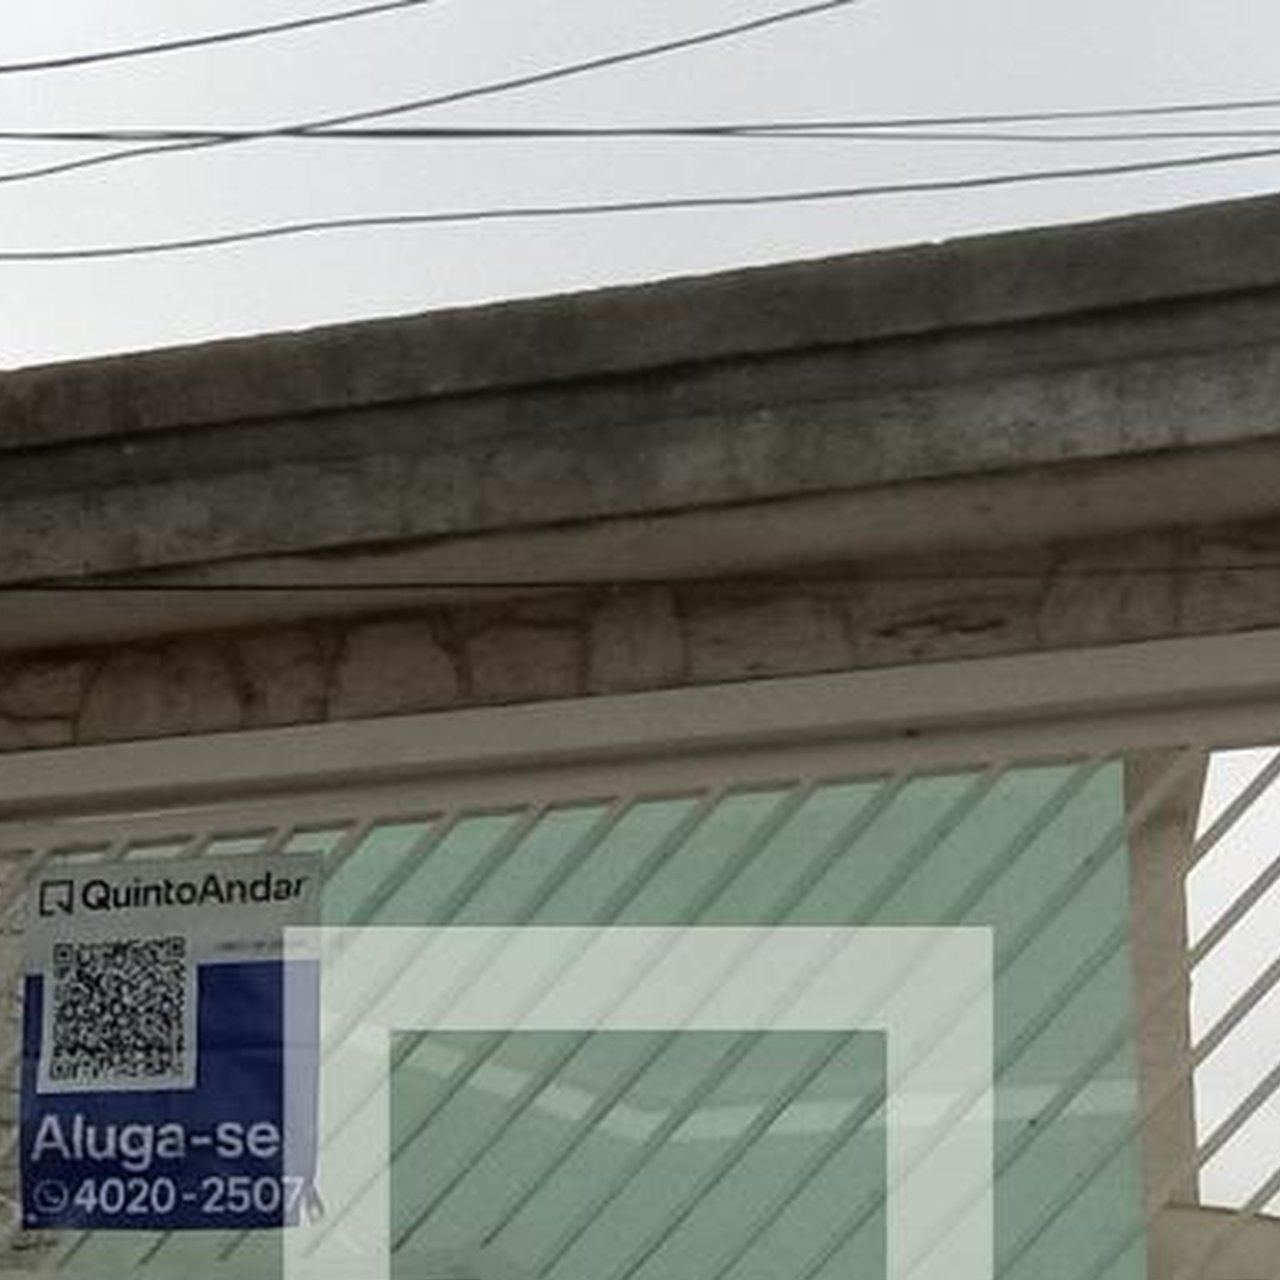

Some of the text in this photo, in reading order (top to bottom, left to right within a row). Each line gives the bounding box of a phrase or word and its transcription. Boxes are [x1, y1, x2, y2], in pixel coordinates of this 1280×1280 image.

[81, 871, 308, 911] QuintoAndar
[30, 1113, 280, 1171] Aluga-se
[73, 1175, 305, 1215] 4020-2507
